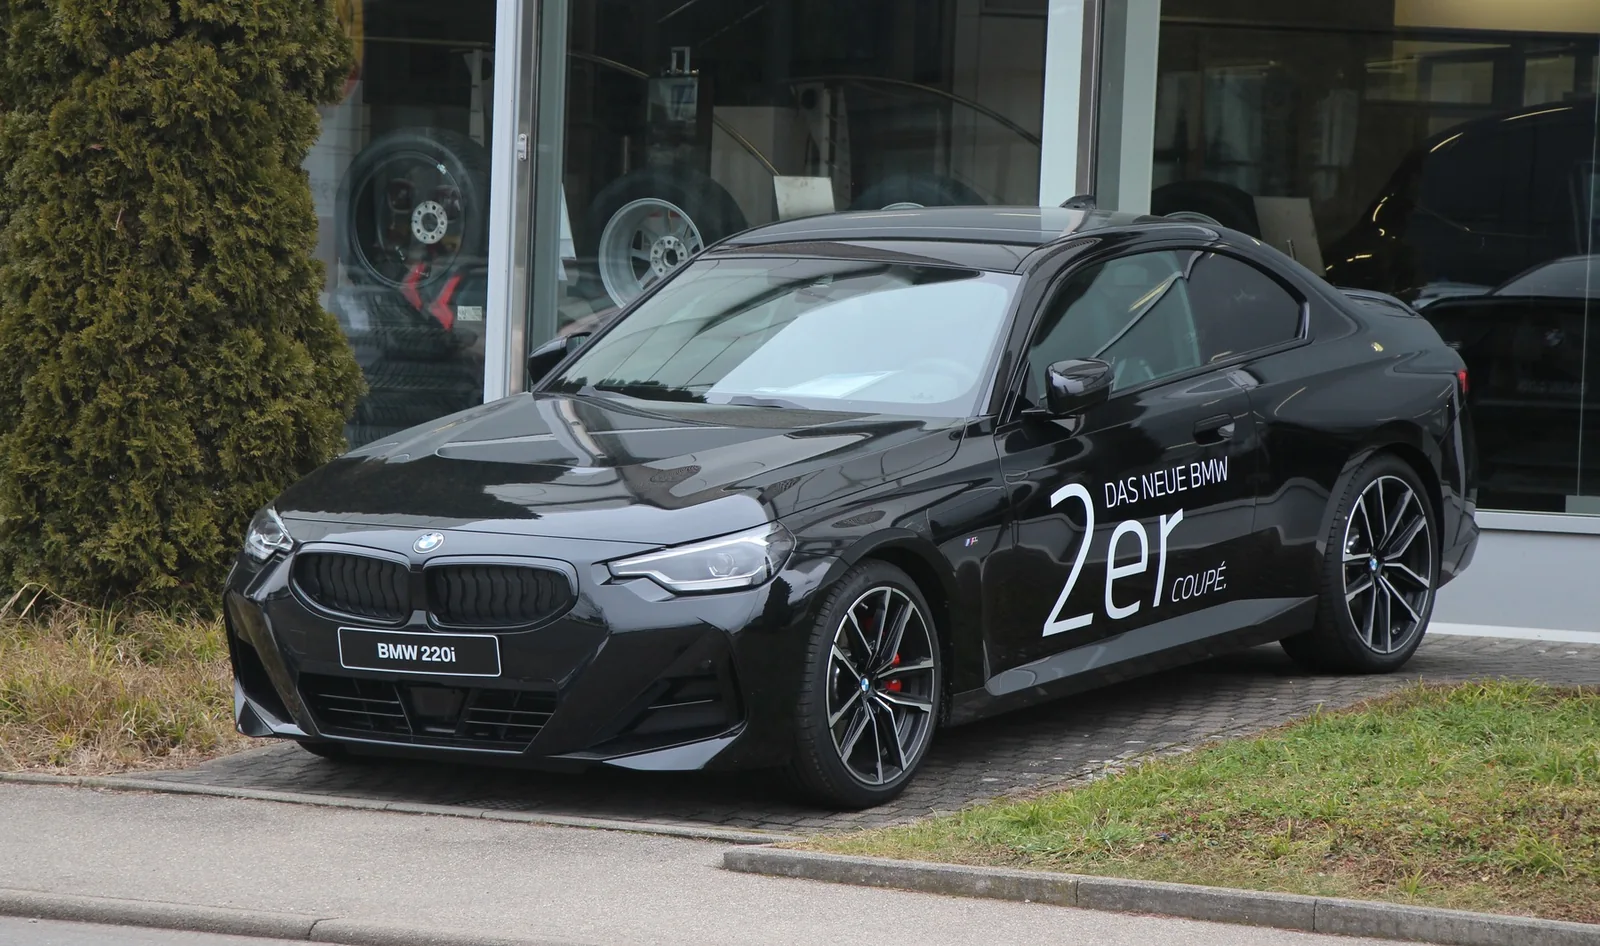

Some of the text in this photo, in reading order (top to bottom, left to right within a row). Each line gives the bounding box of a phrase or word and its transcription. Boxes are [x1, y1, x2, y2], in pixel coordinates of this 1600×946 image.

[1104, 456, 1228, 508] DAS NEUE BMW
[1042, 483, 1227, 637] 2er COUPÉ.
[377, 643, 456, 662] BMW 220i
